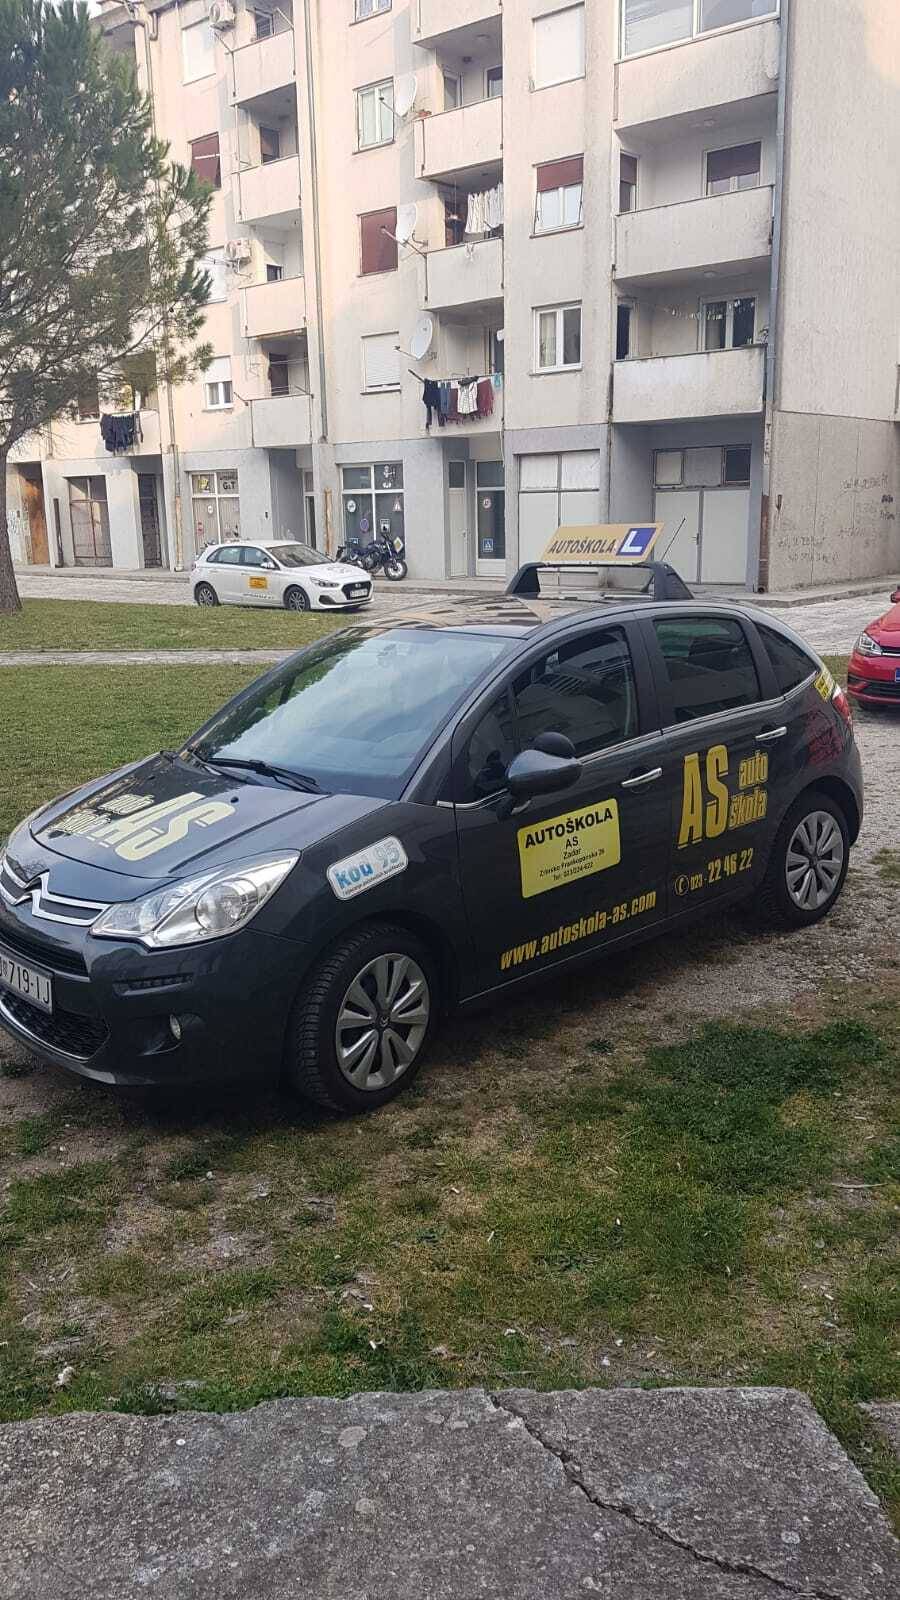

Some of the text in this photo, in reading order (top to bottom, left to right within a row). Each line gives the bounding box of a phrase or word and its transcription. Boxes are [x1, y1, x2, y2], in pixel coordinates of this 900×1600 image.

[548, 537, 616, 554] AUTOŠKOLA
[620, 531, 642, 553] L
[738, 750, 769, 790] auto
[678, 745, 729, 849] AS
[86, 791, 236, 861] AS
[525, 807, 613, 848] AUTOŠKOLA
[565, 836, 579, 849] AS
[708, 859, 722, 884] 22
[724, 853, 738, 877] 46
[739, 848, 754, 872] 22
[500, 891, 657, 970] www.autoskola-as.com
